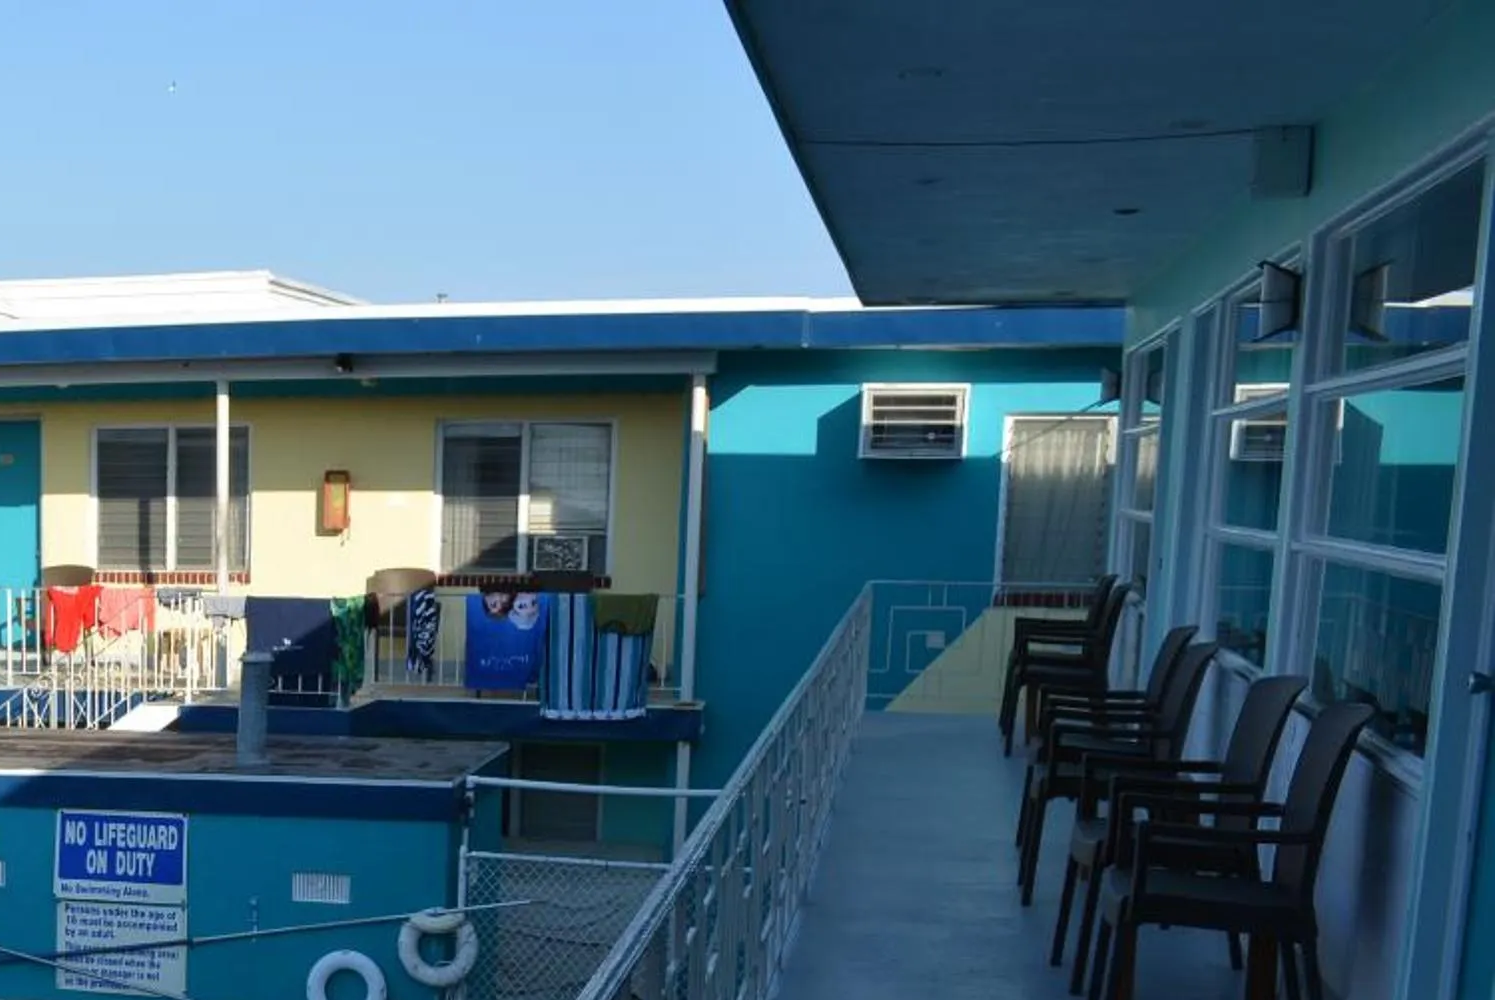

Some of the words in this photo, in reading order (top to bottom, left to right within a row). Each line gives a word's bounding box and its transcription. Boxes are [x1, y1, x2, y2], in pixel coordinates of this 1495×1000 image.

[65, 821, 87, 846] NO
[94, 821, 178, 850] LIFEGUARD
[86, 849, 108, 874] ON
[115, 850, 155, 877] DUTY
[131, 909, 145, 918] the
